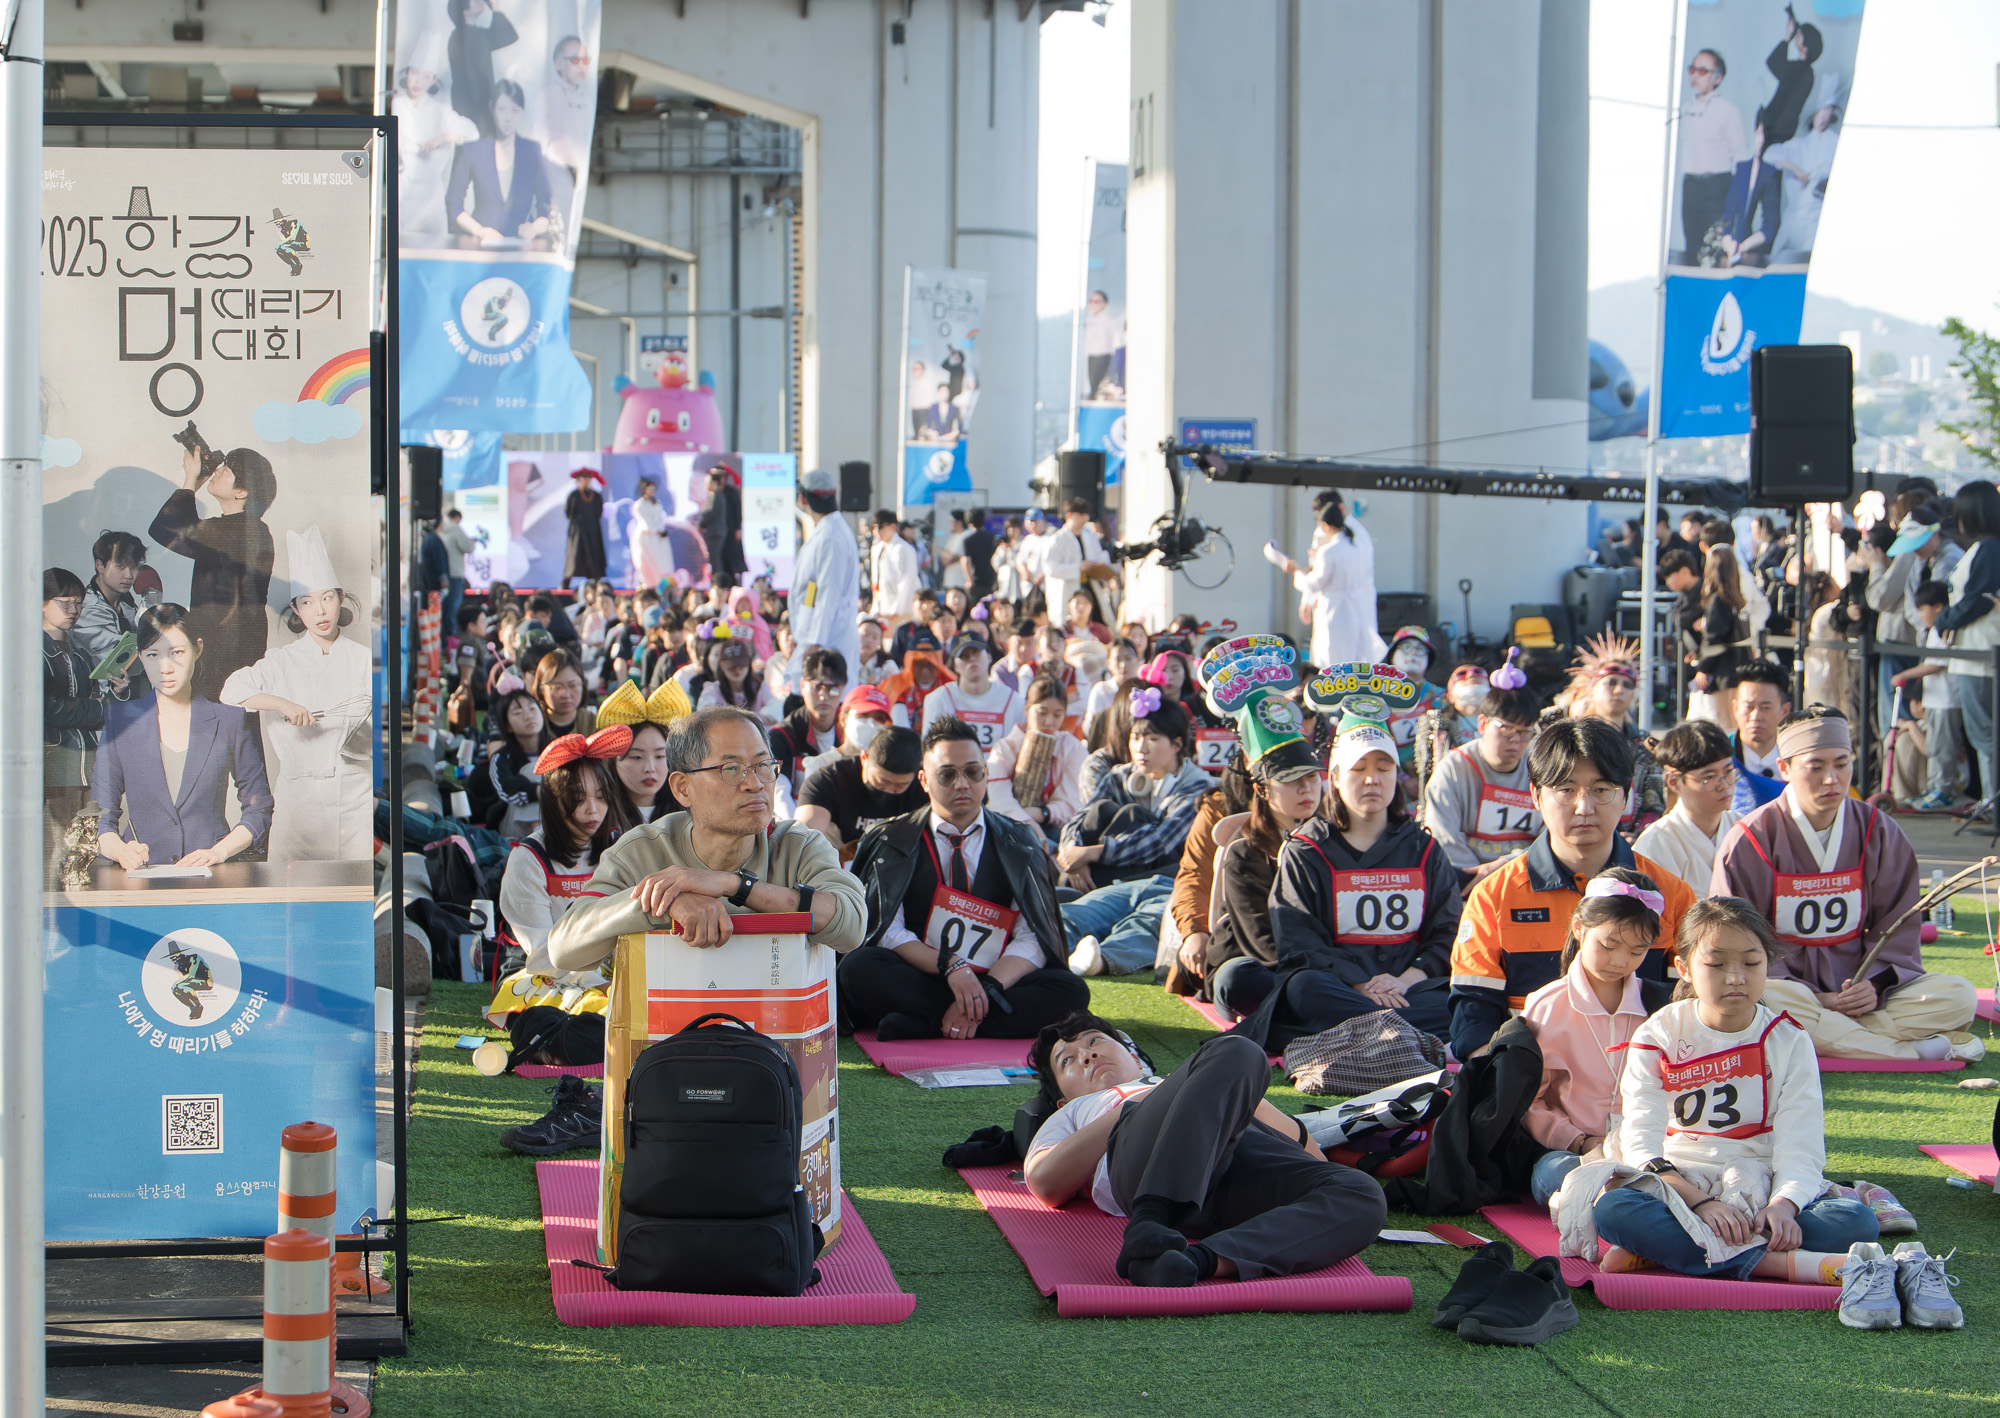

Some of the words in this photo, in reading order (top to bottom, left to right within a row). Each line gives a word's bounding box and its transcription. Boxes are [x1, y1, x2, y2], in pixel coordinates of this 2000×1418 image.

[282, 172, 311, 185] SEOUL
[329, 172, 353, 185] SOUL
[41, 215, 107, 278] 025
[112, 186, 254, 279] 한강
[118, 287, 204, 417] 멍
[211, 288, 342, 320] 때리기
[212, 325, 301, 361] 대회
[1330, 663, 1370, 675] 안심돌봄
[1373, 664, 1397, 677] 120
[1216, 665, 1292, 703] 1668-0120
[1313, 676, 1413, 699] 1668-0120
[1350, 728, 1385, 741] BOSTON
[1208, 742, 1237, 764] 24
[1497, 806, 1533, 832] 14
[562, 880, 587, 892] 멍때
[1350, 874, 1389, 885] 멍때리기
[1391, 873, 1411, 884] 대회
[1792, 878, 1831, 890] 멍때리기
[1831, 875, 1851, 887] 대회
[948, 895, 984, 915] 멍때리기
[984, 908, 1001, 920] 대회
[1356, 893, 1410, 931] 08
[1794, 897, 1848, 935] 09
[941, 917, 993, 961] 07
[117, 990, 153, 1038] 나에게
[149, 1028, 168, 1048] 멍
[168, 1029, 233, 1055] 때리기를
[230, 988, 268, 1036] 허하라!
[1667, 1062, 1719, 1084] 멍때리기
[1720, 1054, 1741, 1072] 대회
[1673, 1083, 1741, 1129] 03
[136, 1183, 186, 1199] 한강공원
